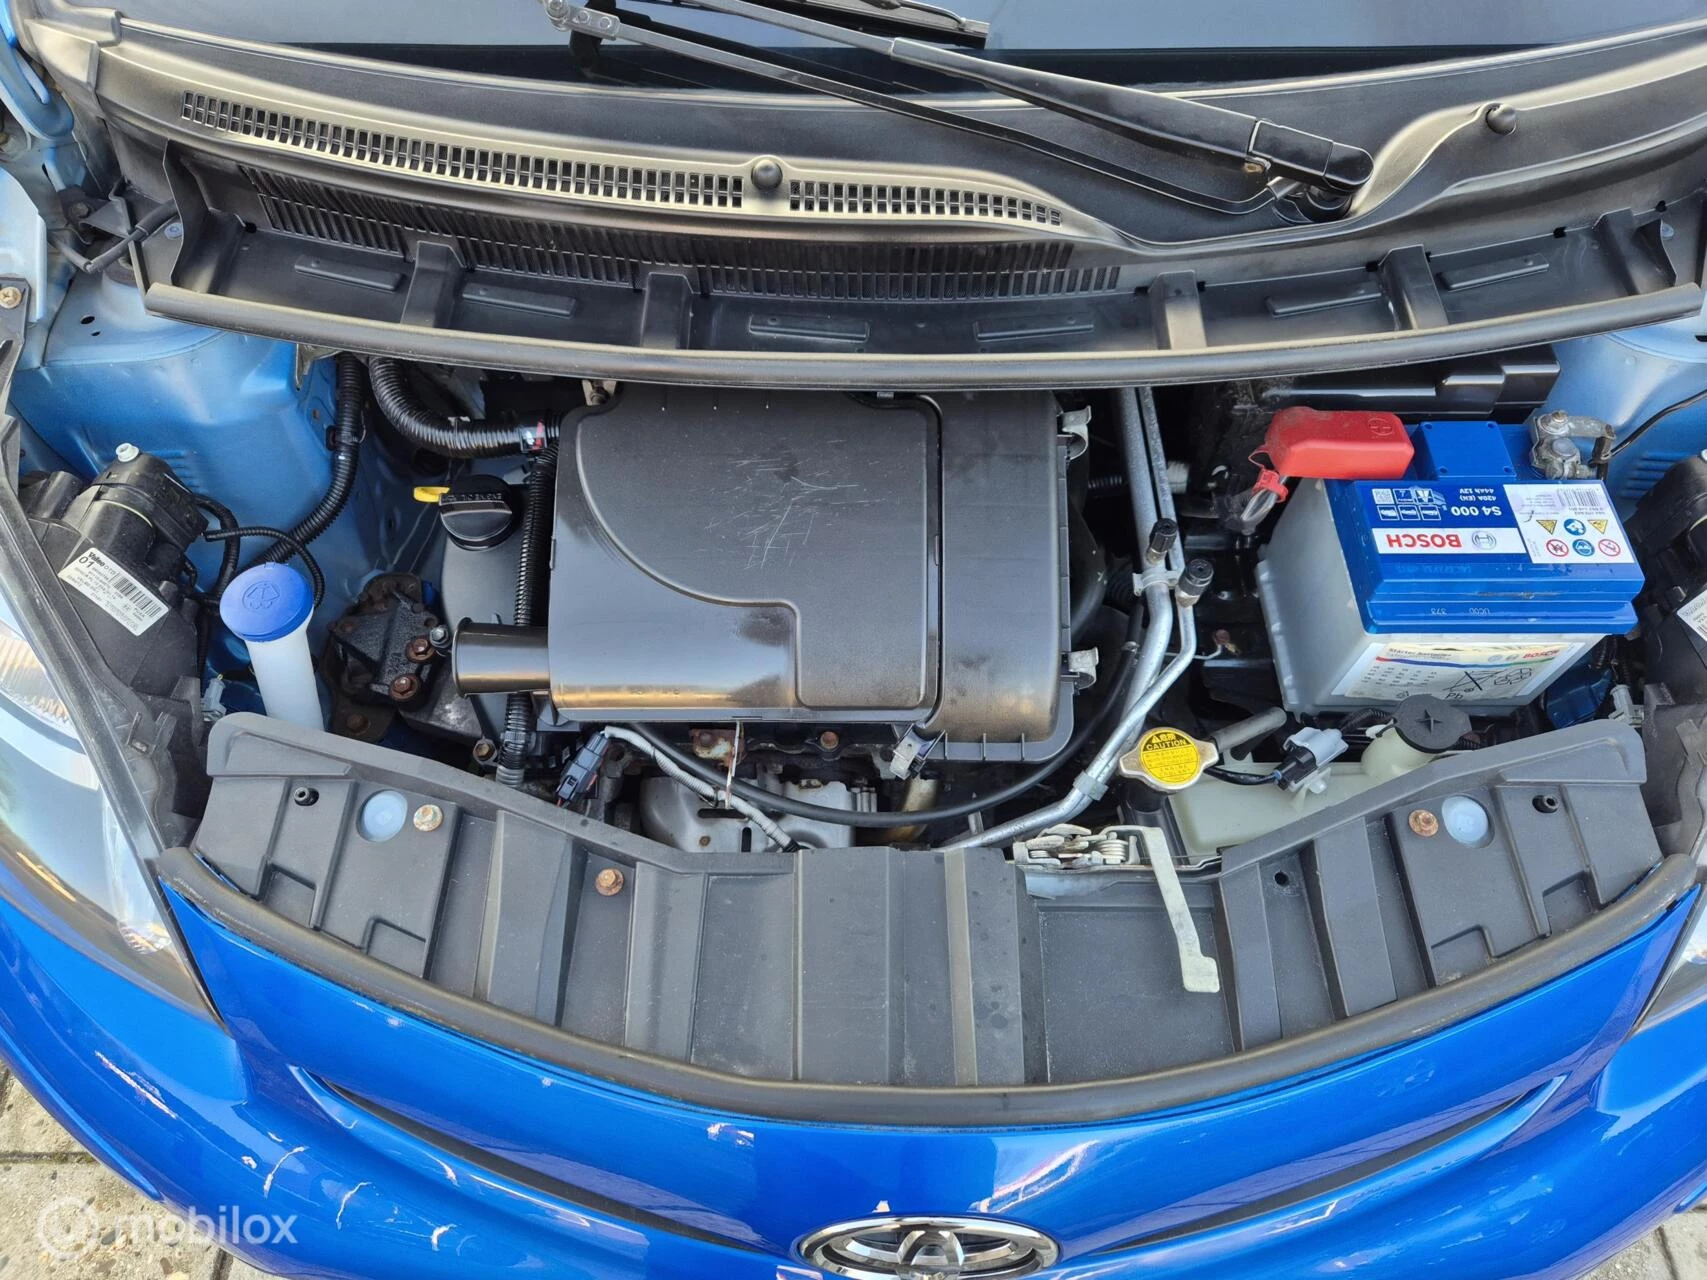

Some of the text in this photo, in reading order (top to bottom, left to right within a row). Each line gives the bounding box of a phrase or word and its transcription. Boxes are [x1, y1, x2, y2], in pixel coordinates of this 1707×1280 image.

[1450, 505, 1502, 517] S4 000
[1386, 533, 1462, 548] BOSCH
[78, 556, 94, 568] 01
[1146, 739, 1186, 751] CAUTION
